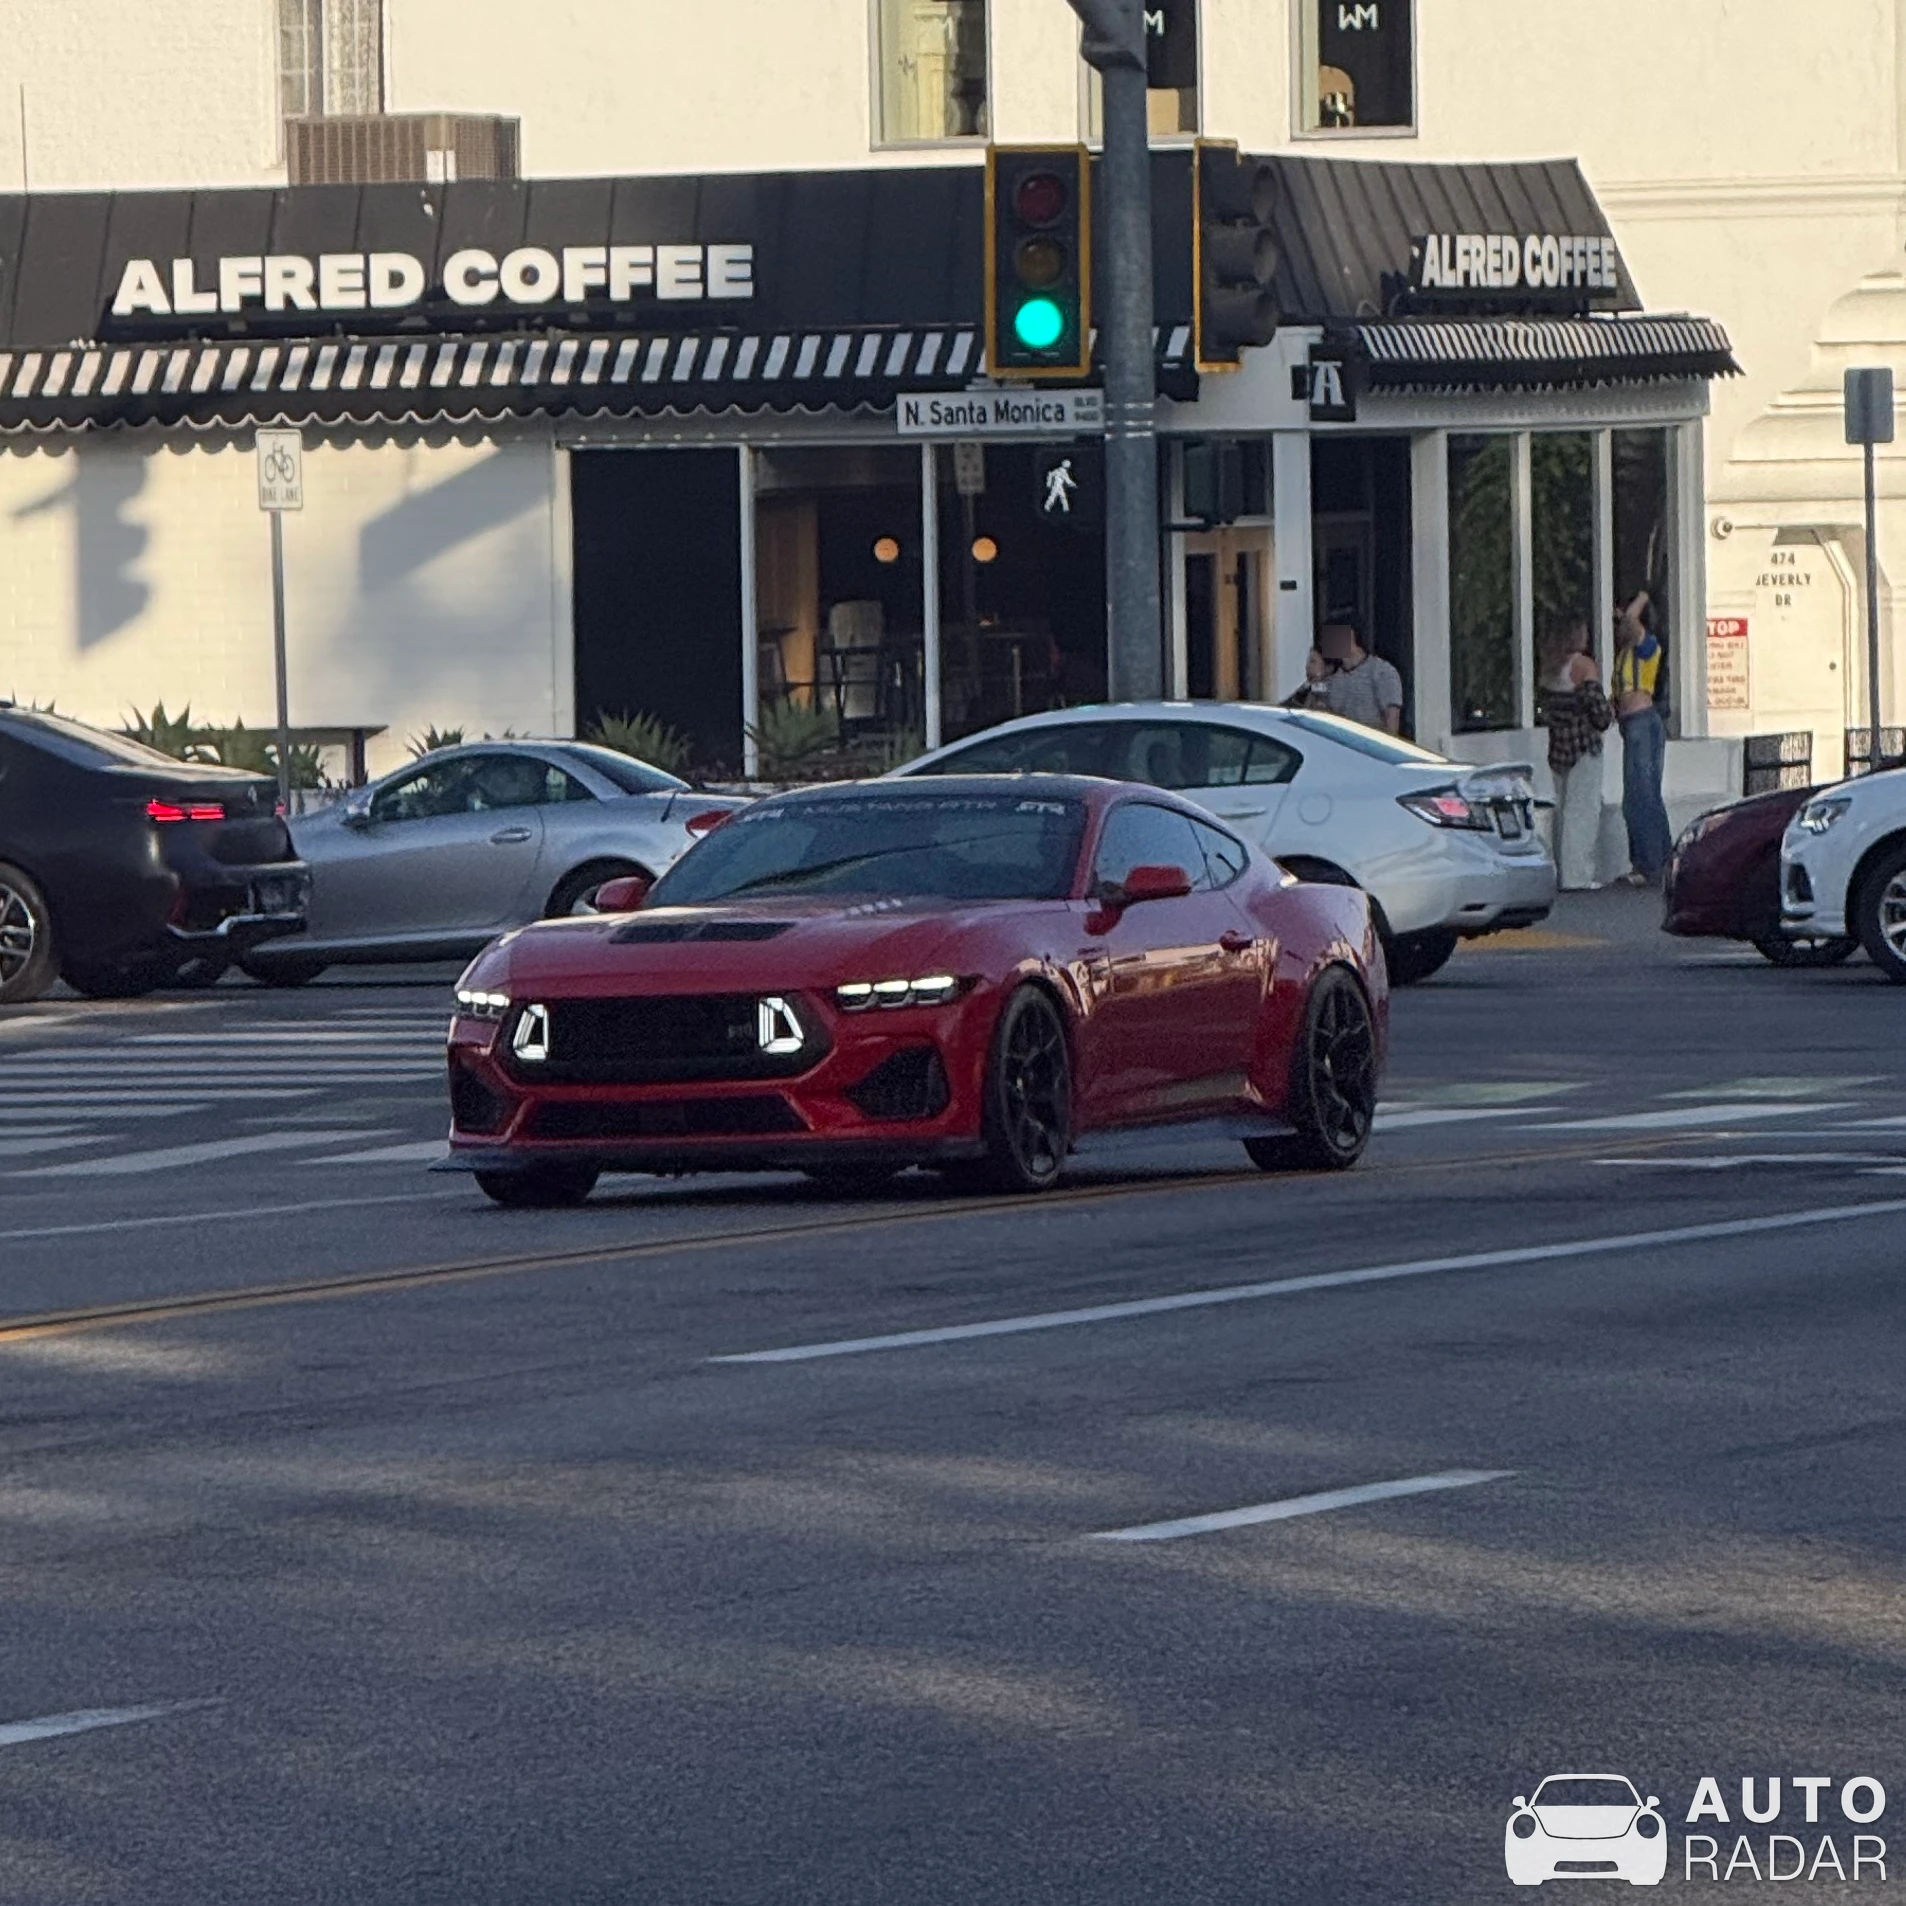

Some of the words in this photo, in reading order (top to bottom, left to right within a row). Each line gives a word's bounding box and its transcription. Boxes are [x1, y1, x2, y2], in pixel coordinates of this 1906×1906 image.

[1142, 9, 1163, 36] M
[1338, 3, 1378, 30] WM
[1421, 234, 1520, 288] ALFRED
[1523, 234, 1617, 288] COFFEE
[111, 252, 425, 316] ALFRED
[443, 244, 753, 305] COFFEE
[1311, 361, 1346, 406] A
[905, 400, 925, 426] N.
[929, 399, 988, 425] Santa
[994, 397, 1066, 424] Monica
[1770, 552, 1796, 565] 474
[1775, 593, 1792, 606] DR
[1707, 620, 1740, 636] TOP
